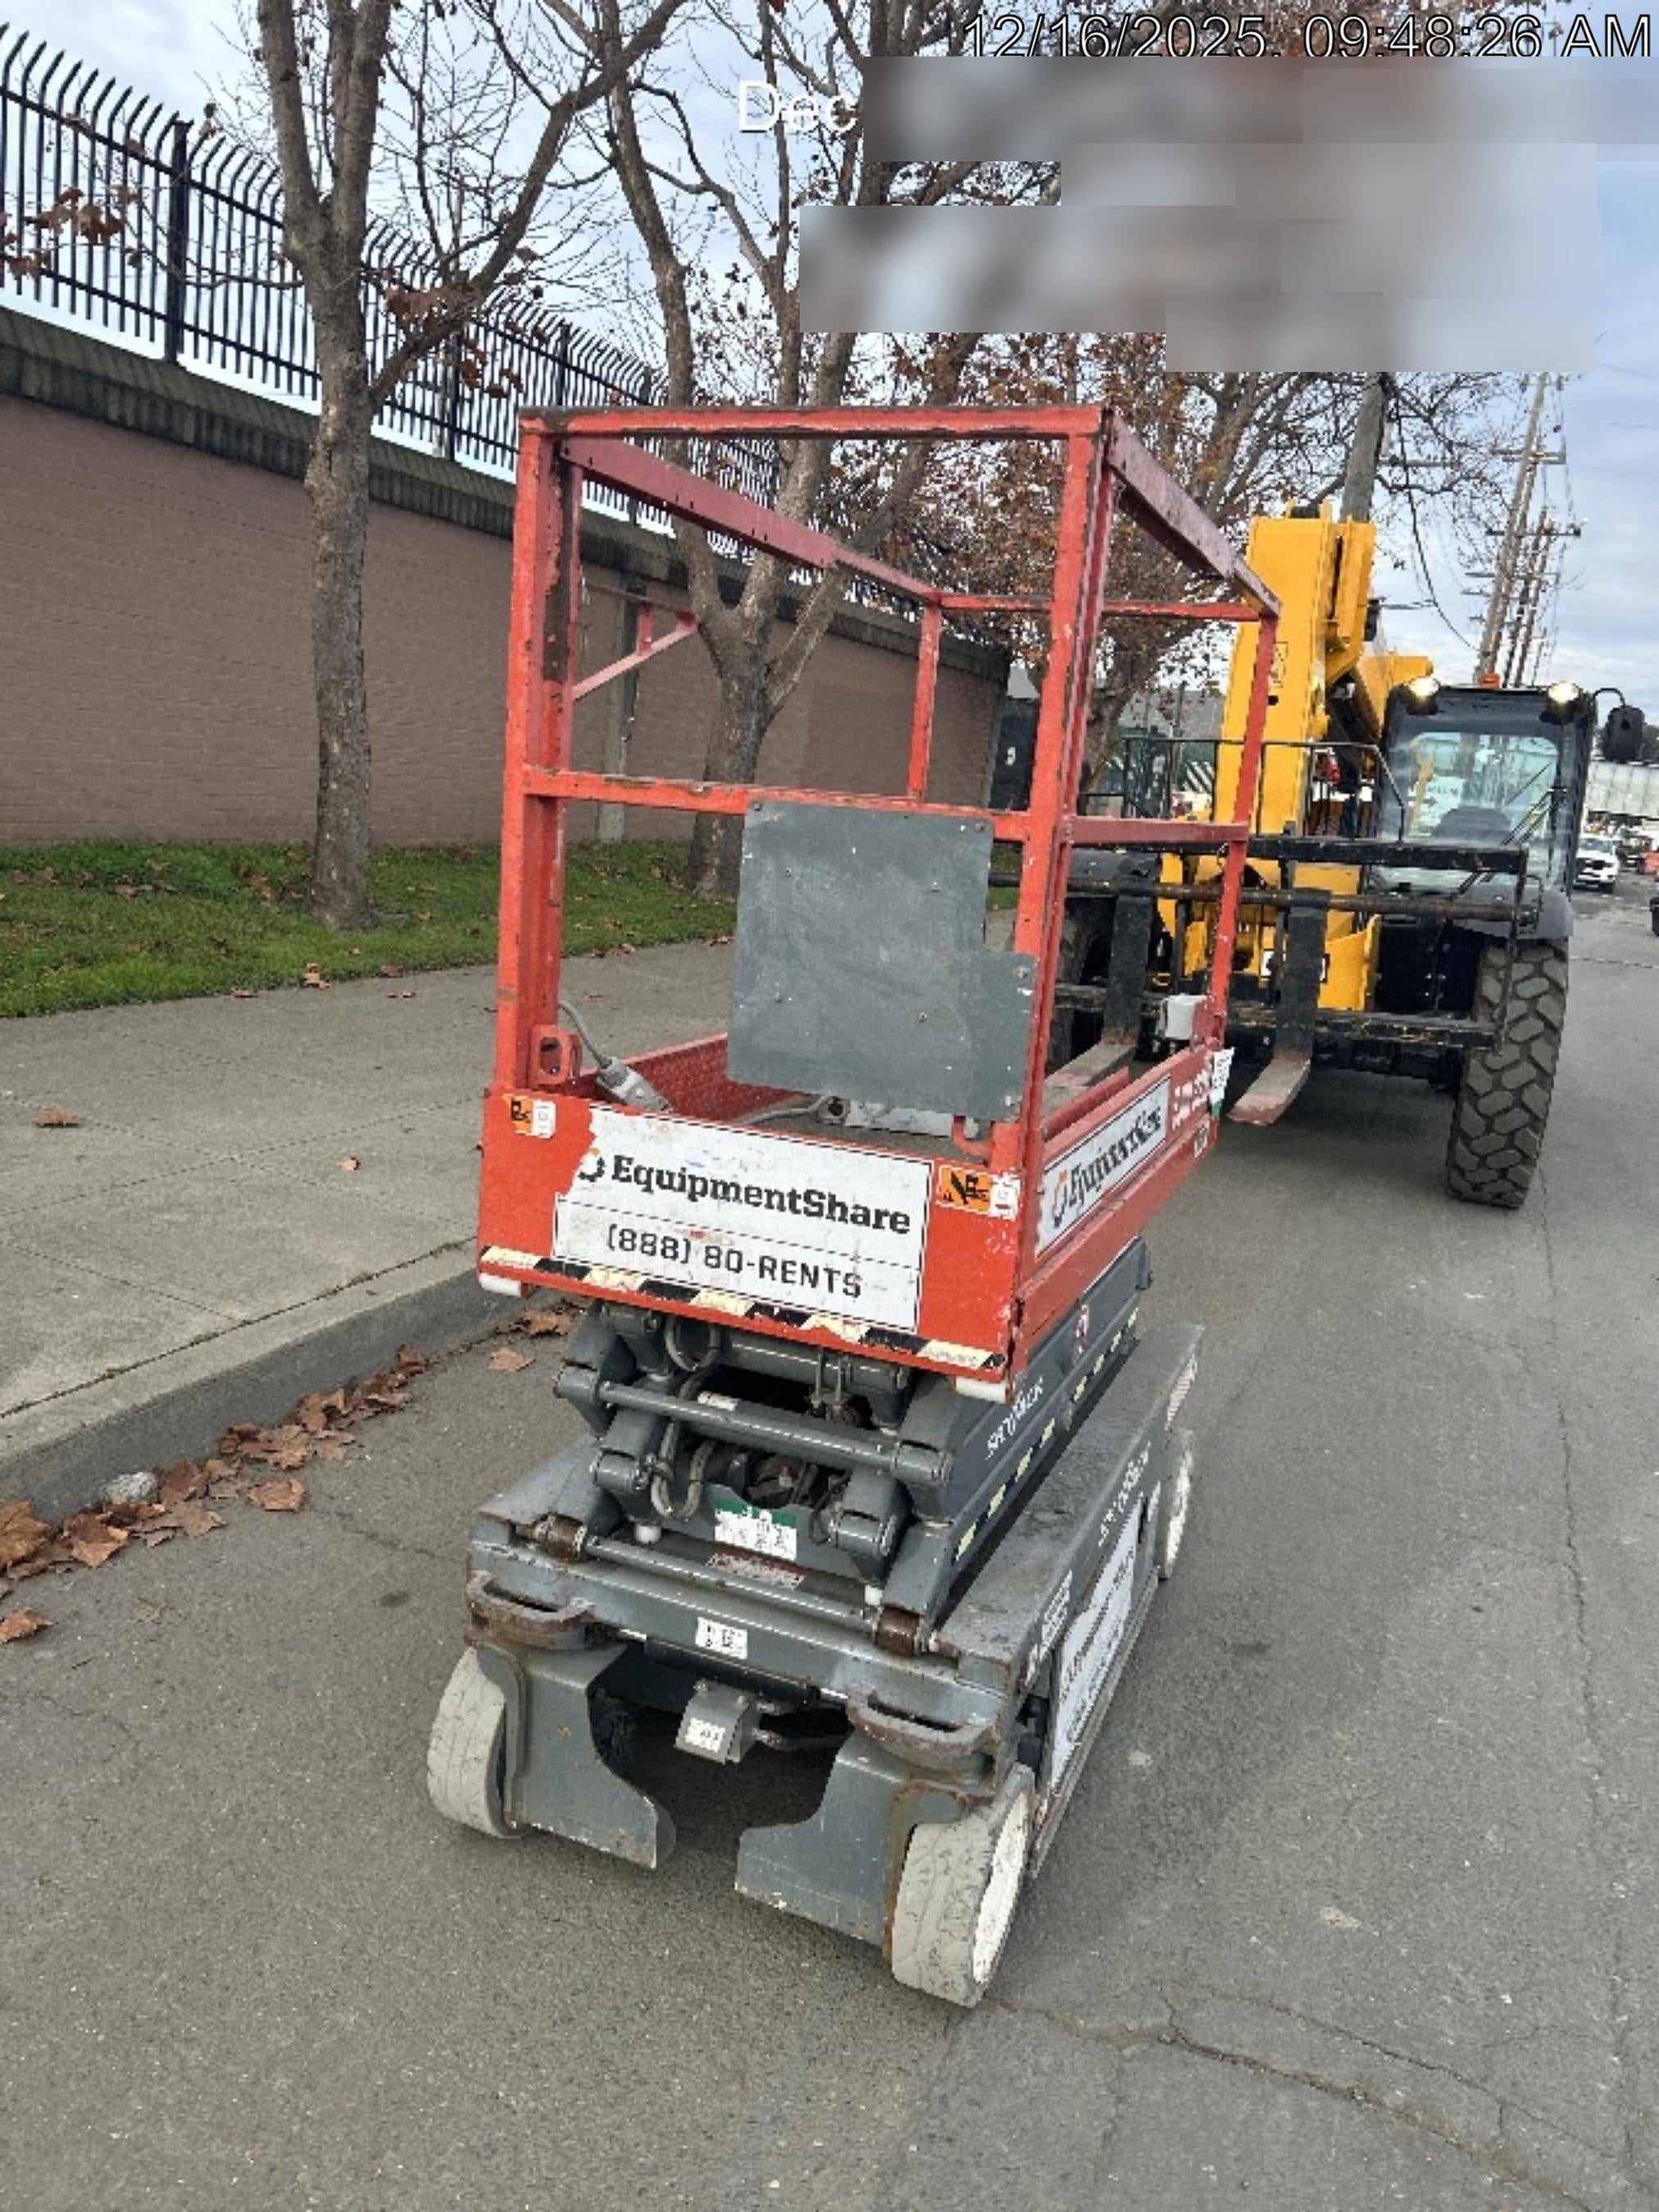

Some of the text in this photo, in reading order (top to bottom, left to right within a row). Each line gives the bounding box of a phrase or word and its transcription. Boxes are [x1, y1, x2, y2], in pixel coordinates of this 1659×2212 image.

[612, 1154, 910, 1235] EquipmentShare
[607, 1222, 862, 1299] (888) 80-RENTS
